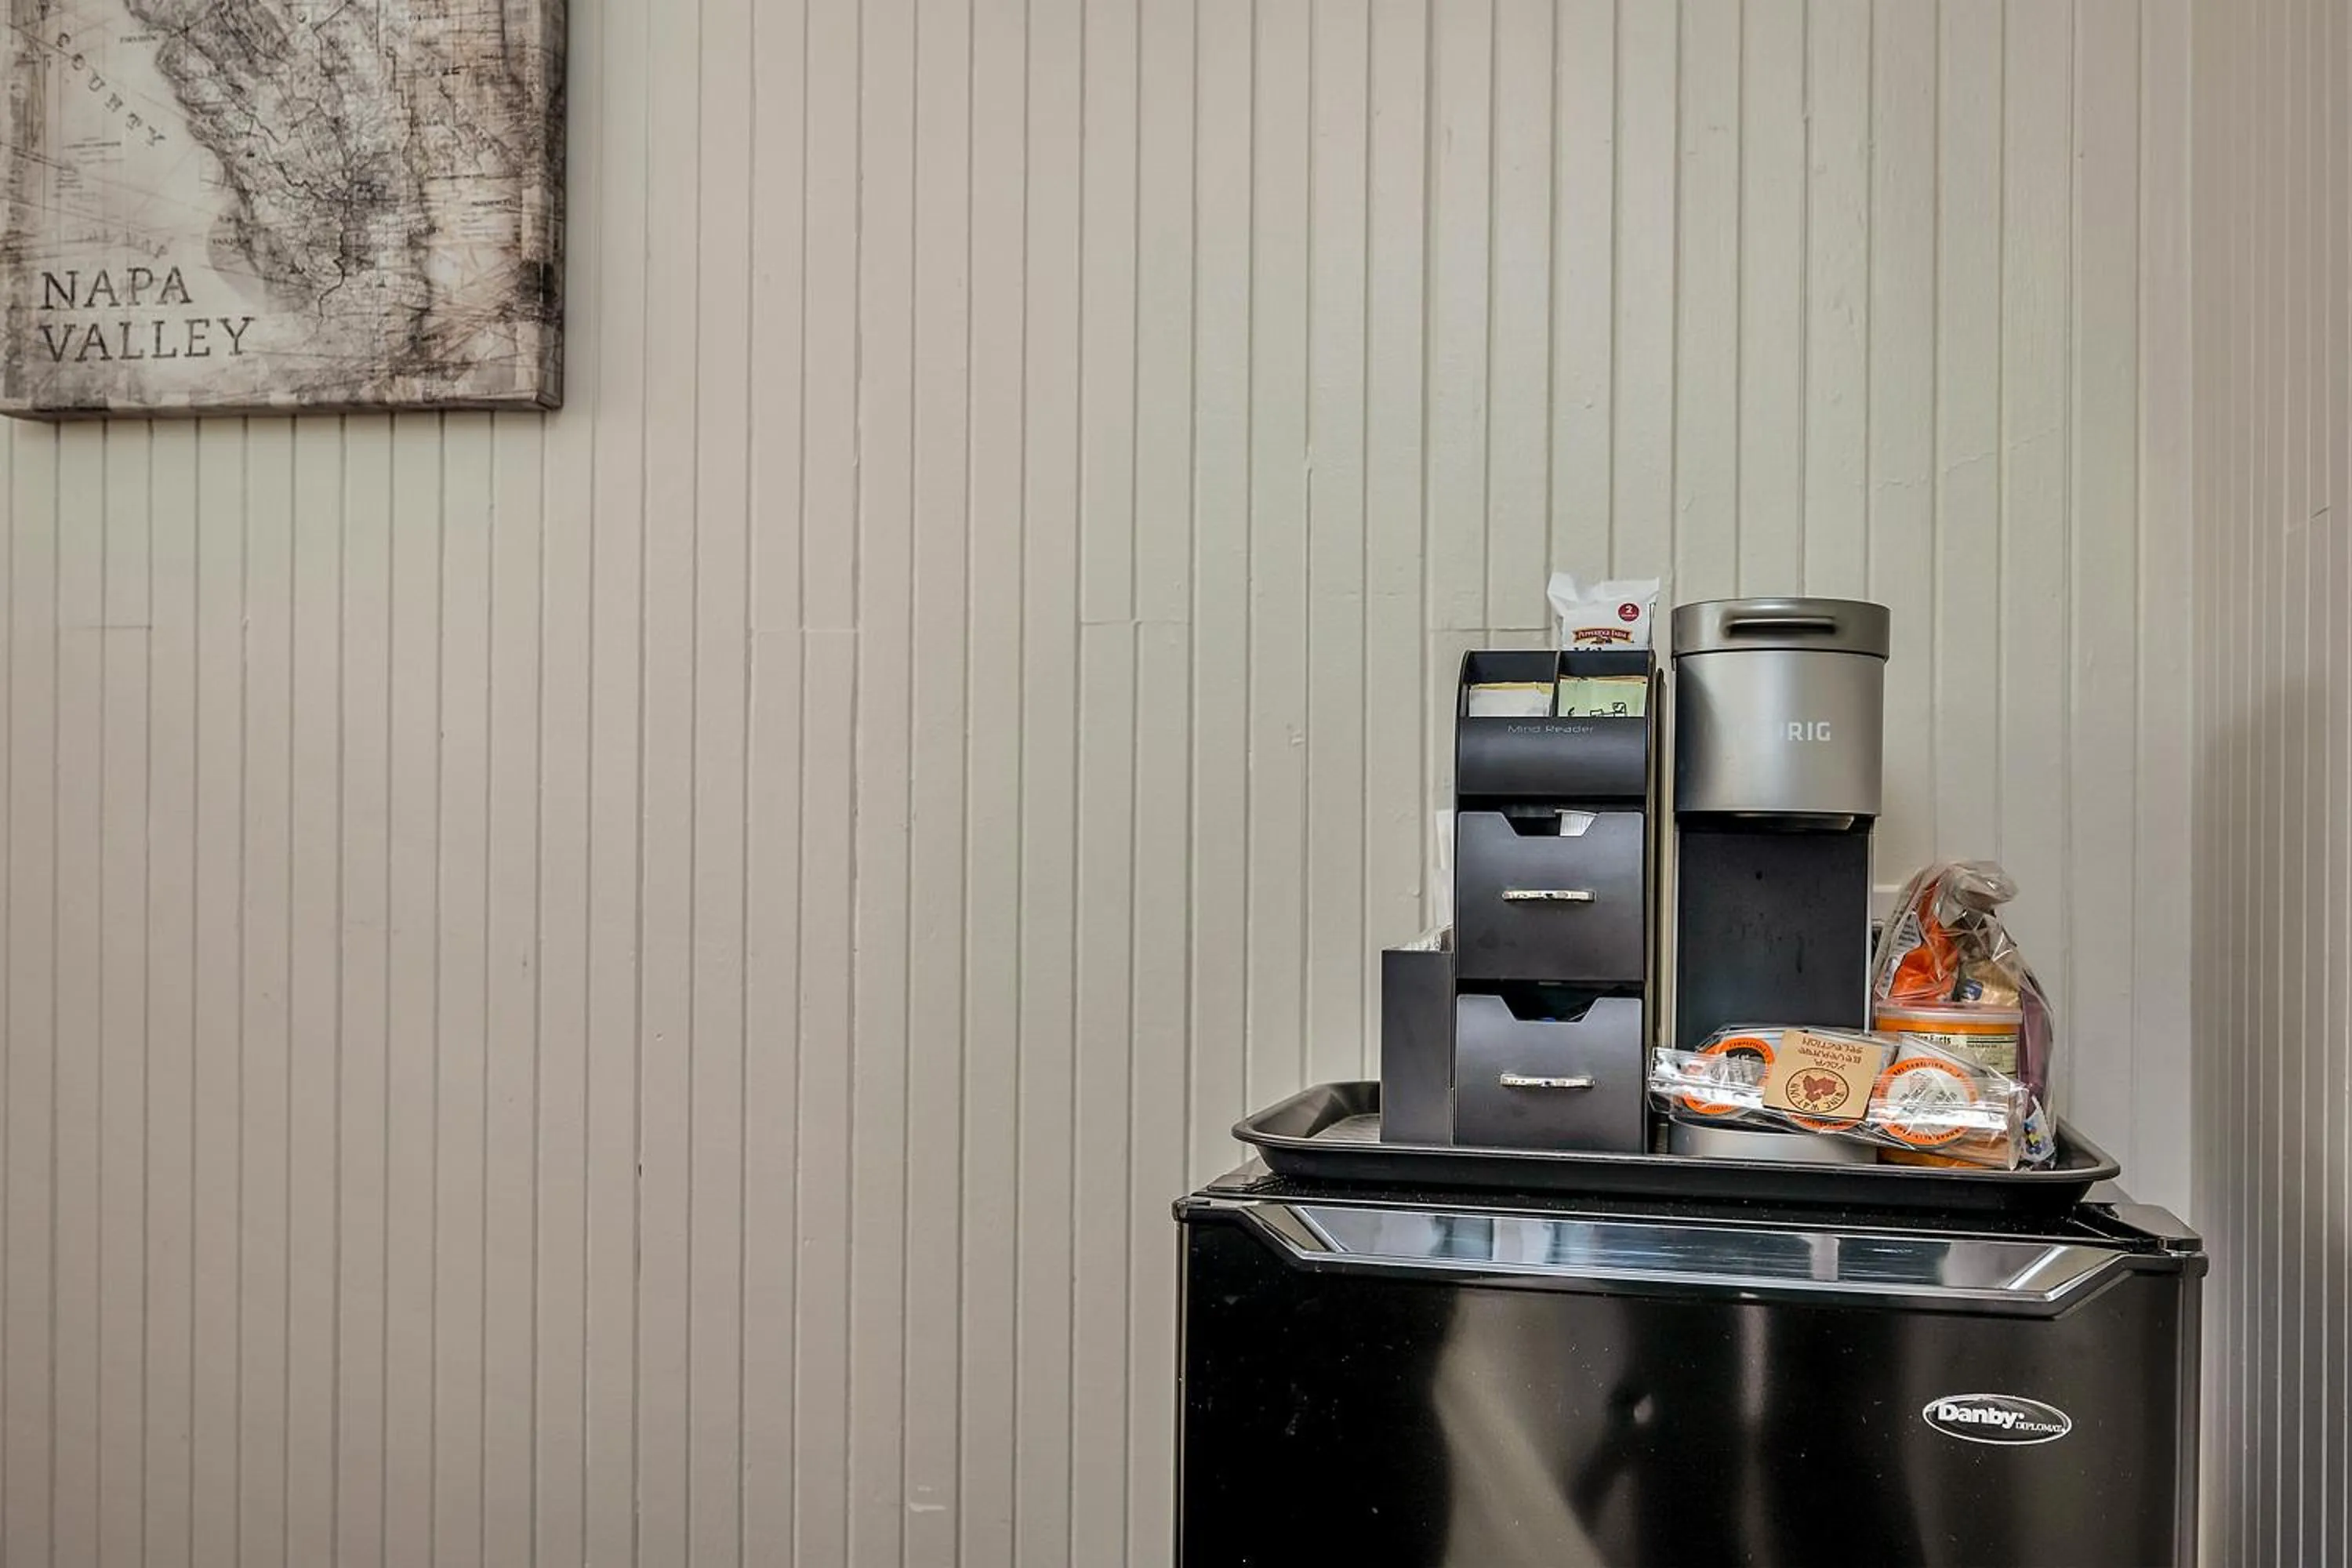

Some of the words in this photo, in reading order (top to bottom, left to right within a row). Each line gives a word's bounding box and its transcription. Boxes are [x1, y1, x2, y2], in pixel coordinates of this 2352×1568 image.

[55, 32, 166, 147] COUNTY
[40, 266, 193, 310] NAPA
[38, 317, 256, 363] VALLEY
[1624, 604, 1633, 614] 2
[1508, 724, 1541, 733] Mind
[1545, 724, 1594, 734] Reader
[1936, 1403, 2019, 1428] Danby
[2016, 1421, 2064, 1433] DIPLOMAT
